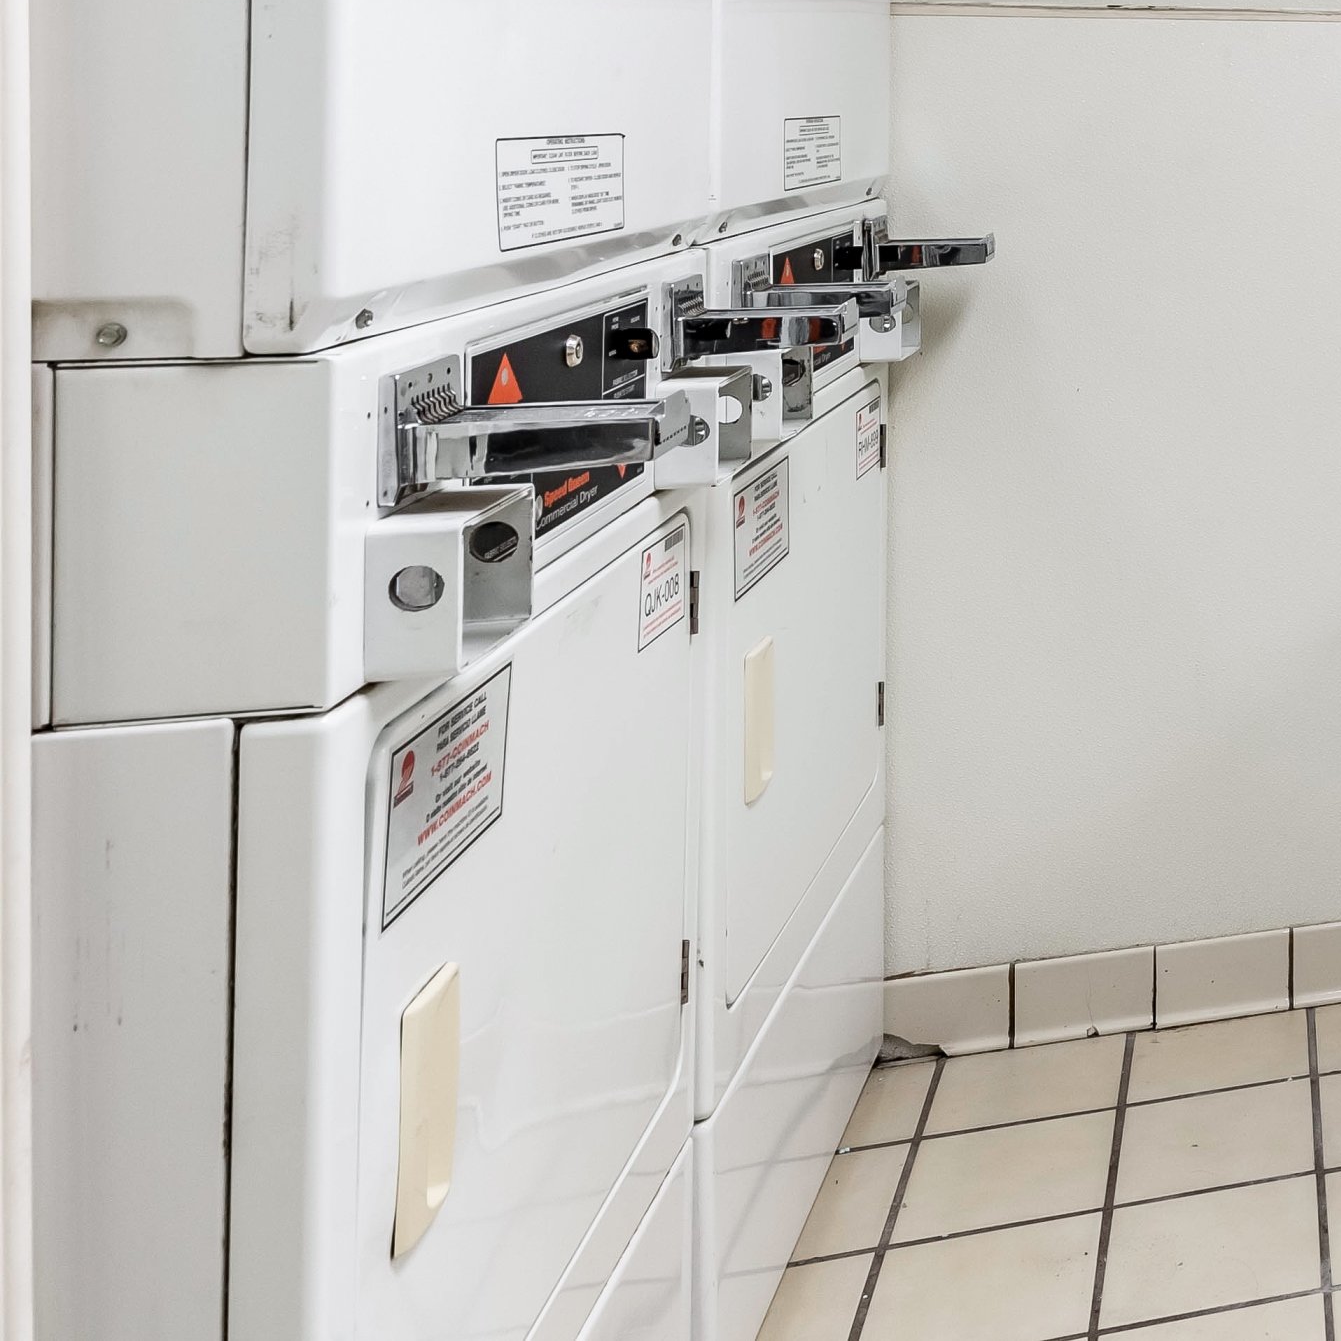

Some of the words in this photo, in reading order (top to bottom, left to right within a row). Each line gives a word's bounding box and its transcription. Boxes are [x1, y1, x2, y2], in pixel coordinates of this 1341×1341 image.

[536, 494, 578, 530] Commercial
[579, 485, 598, 506] Dryer
[544, 480, 567, 508] Speed
[568, 471, 590, 495] Queen
[644, 571, 679, 619] QJK-008
[437, 720, 449, 739] FOR
[450, 702, 472, 729] SERVICE
[474, 690, 487, 710] CALL
[430, 720, 489, 779] 1-877-COINMACH
[417, 770, 492, 848] WWW.COINMACH.COM
